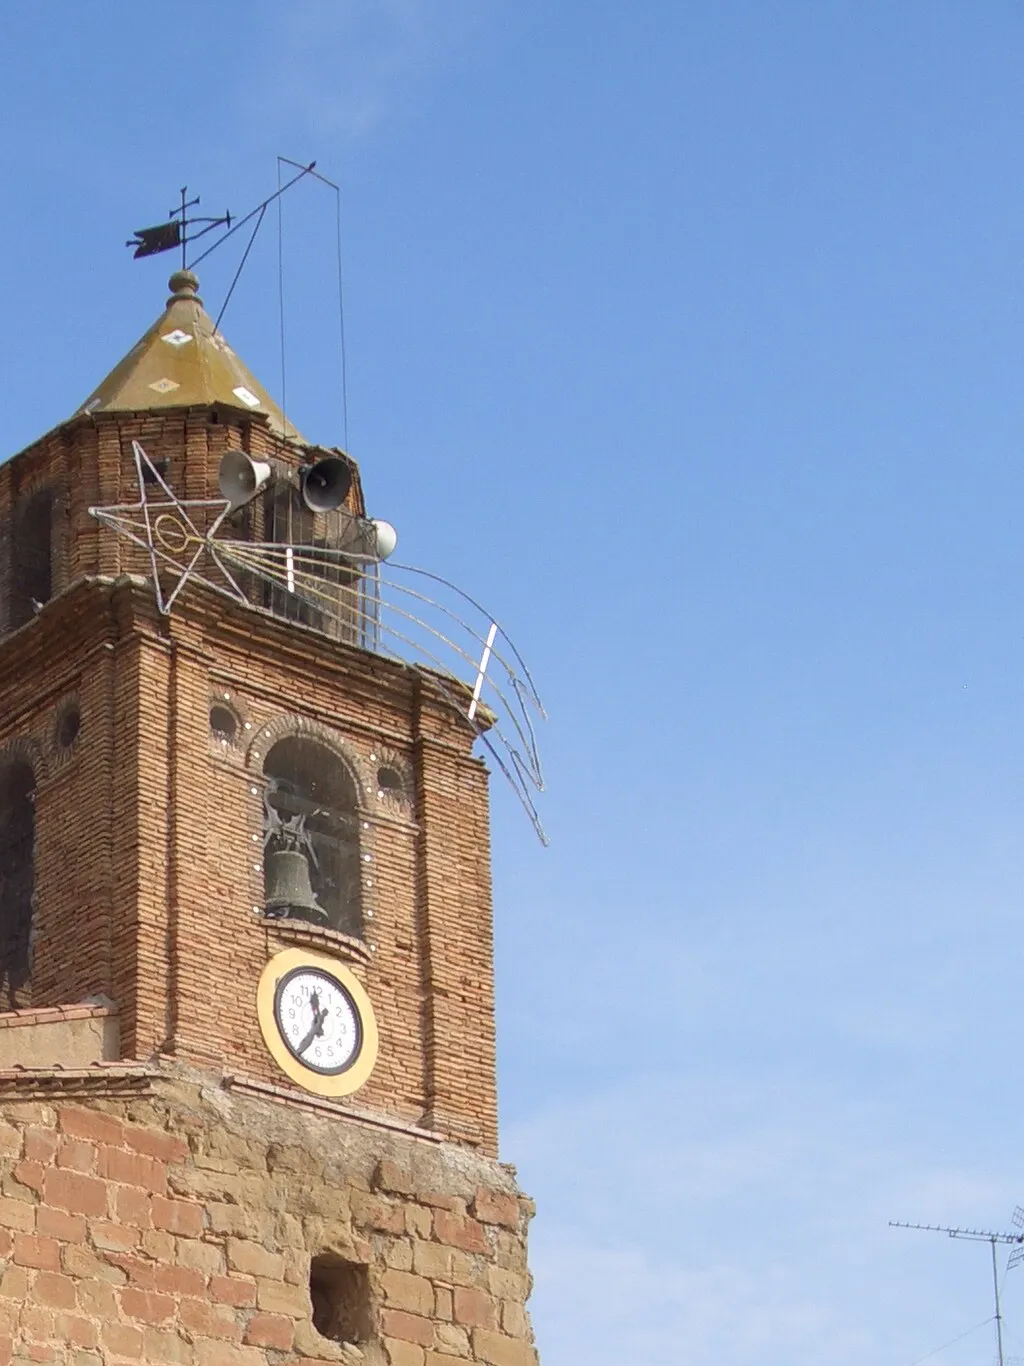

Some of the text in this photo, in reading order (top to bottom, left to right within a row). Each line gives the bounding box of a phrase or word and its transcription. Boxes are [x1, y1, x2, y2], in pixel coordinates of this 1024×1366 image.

[300, 984, 309, 997] 11
[290, 994, 302, 1008] 10
[288, 1008, 295, 1019] 9
[336, 1006, 342, 1018] 2
[292, 1024, 299, 1036] 8
[340, 1023, 346, 1034] 3
[336, 1038, 342, 1048] 4
[315, 1046, 321, 1057] 6
[327, 1046, 333, 1057] 5
